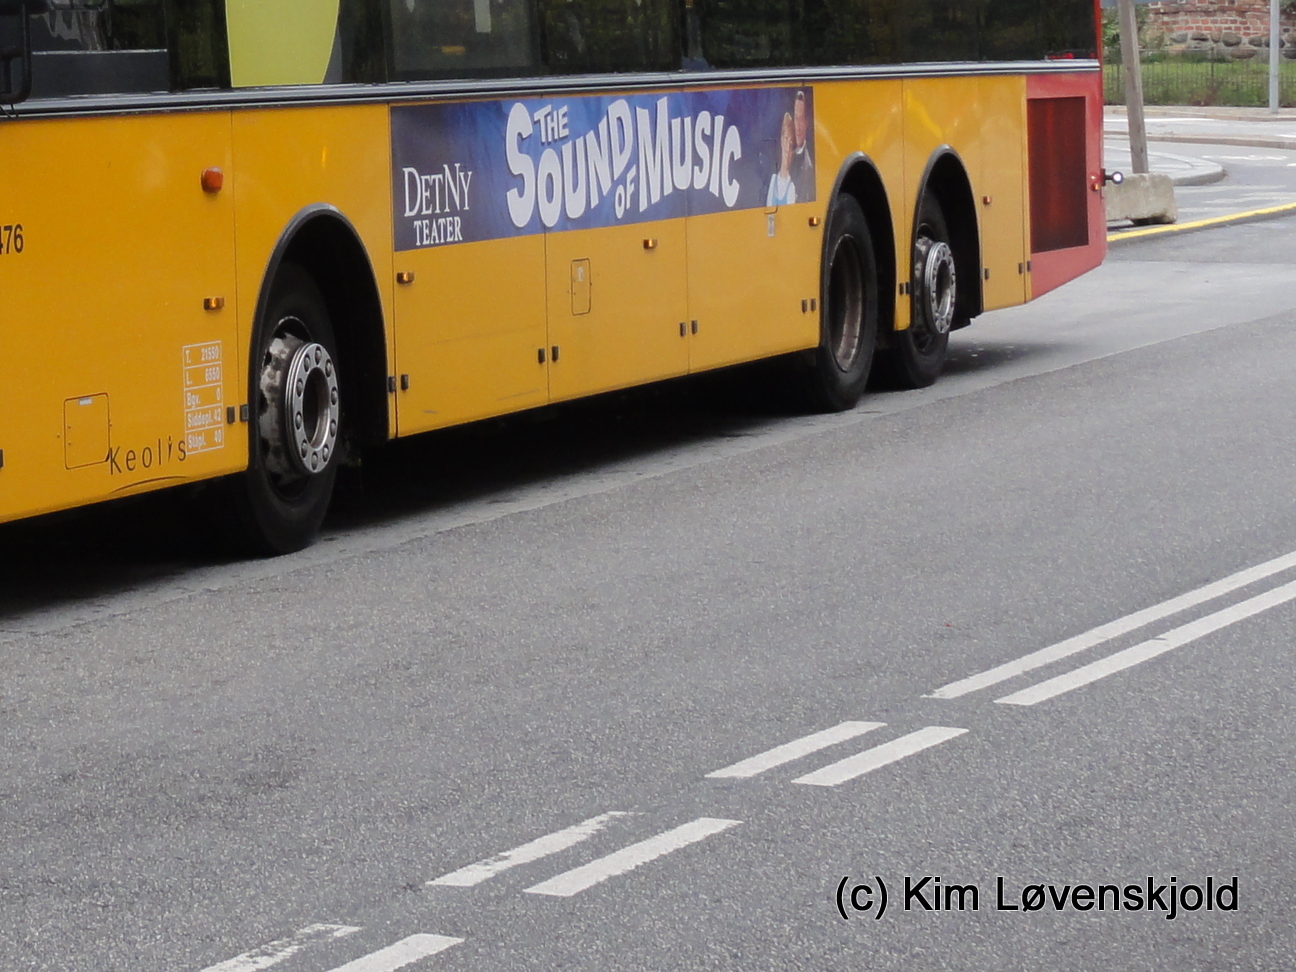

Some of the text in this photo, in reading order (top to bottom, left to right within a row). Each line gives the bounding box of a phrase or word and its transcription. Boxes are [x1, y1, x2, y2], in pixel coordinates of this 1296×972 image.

[534, 104, 570, 144] THE
[506, 96, 742, 228] SOUND OF MUSIC
[414, 216, 464, 247] TEATER
[109, 434, 187, 475] Keolis
